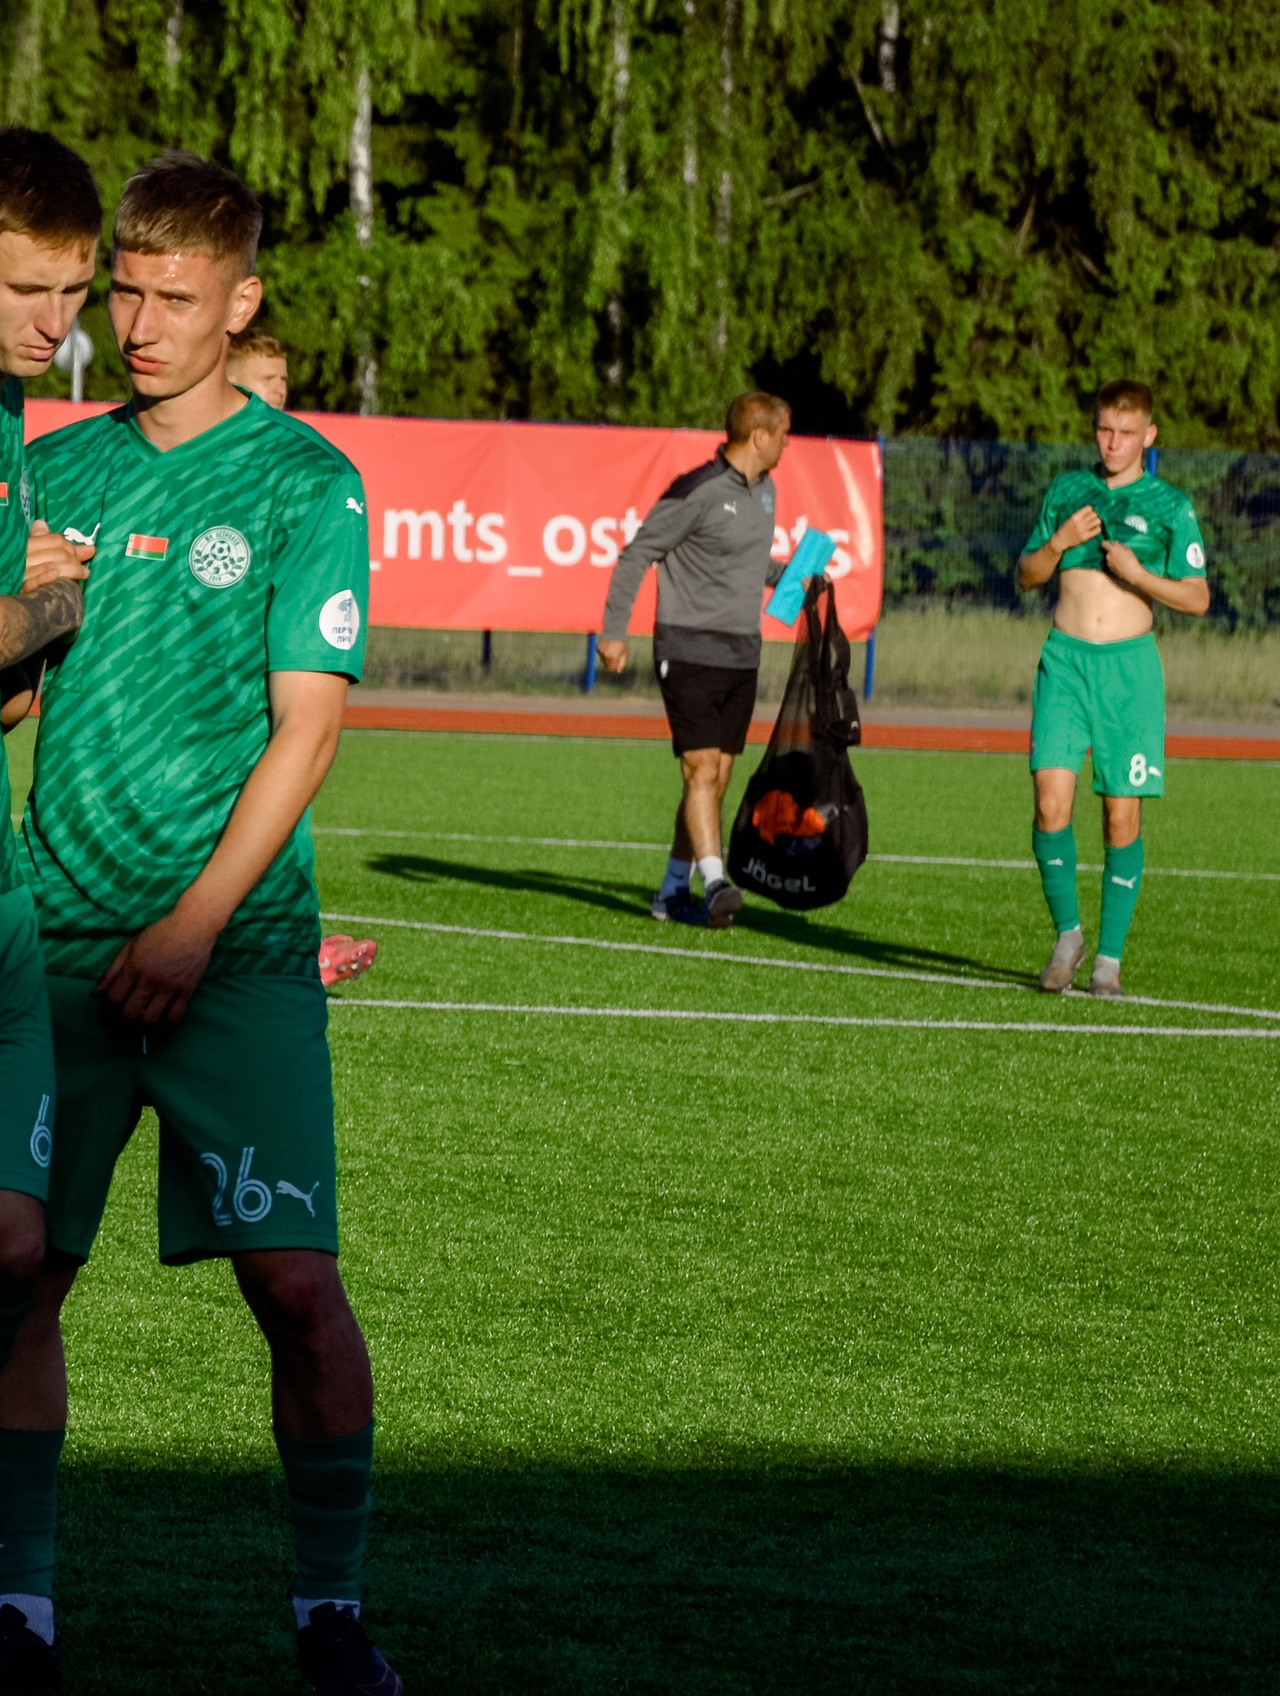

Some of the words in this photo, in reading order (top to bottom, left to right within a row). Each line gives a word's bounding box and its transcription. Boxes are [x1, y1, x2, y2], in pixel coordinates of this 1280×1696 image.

[1128, 753, 1147, 787] 8
[30, 1093, 53, 1168] 6
[200, 1146, 272, 1226] 26
